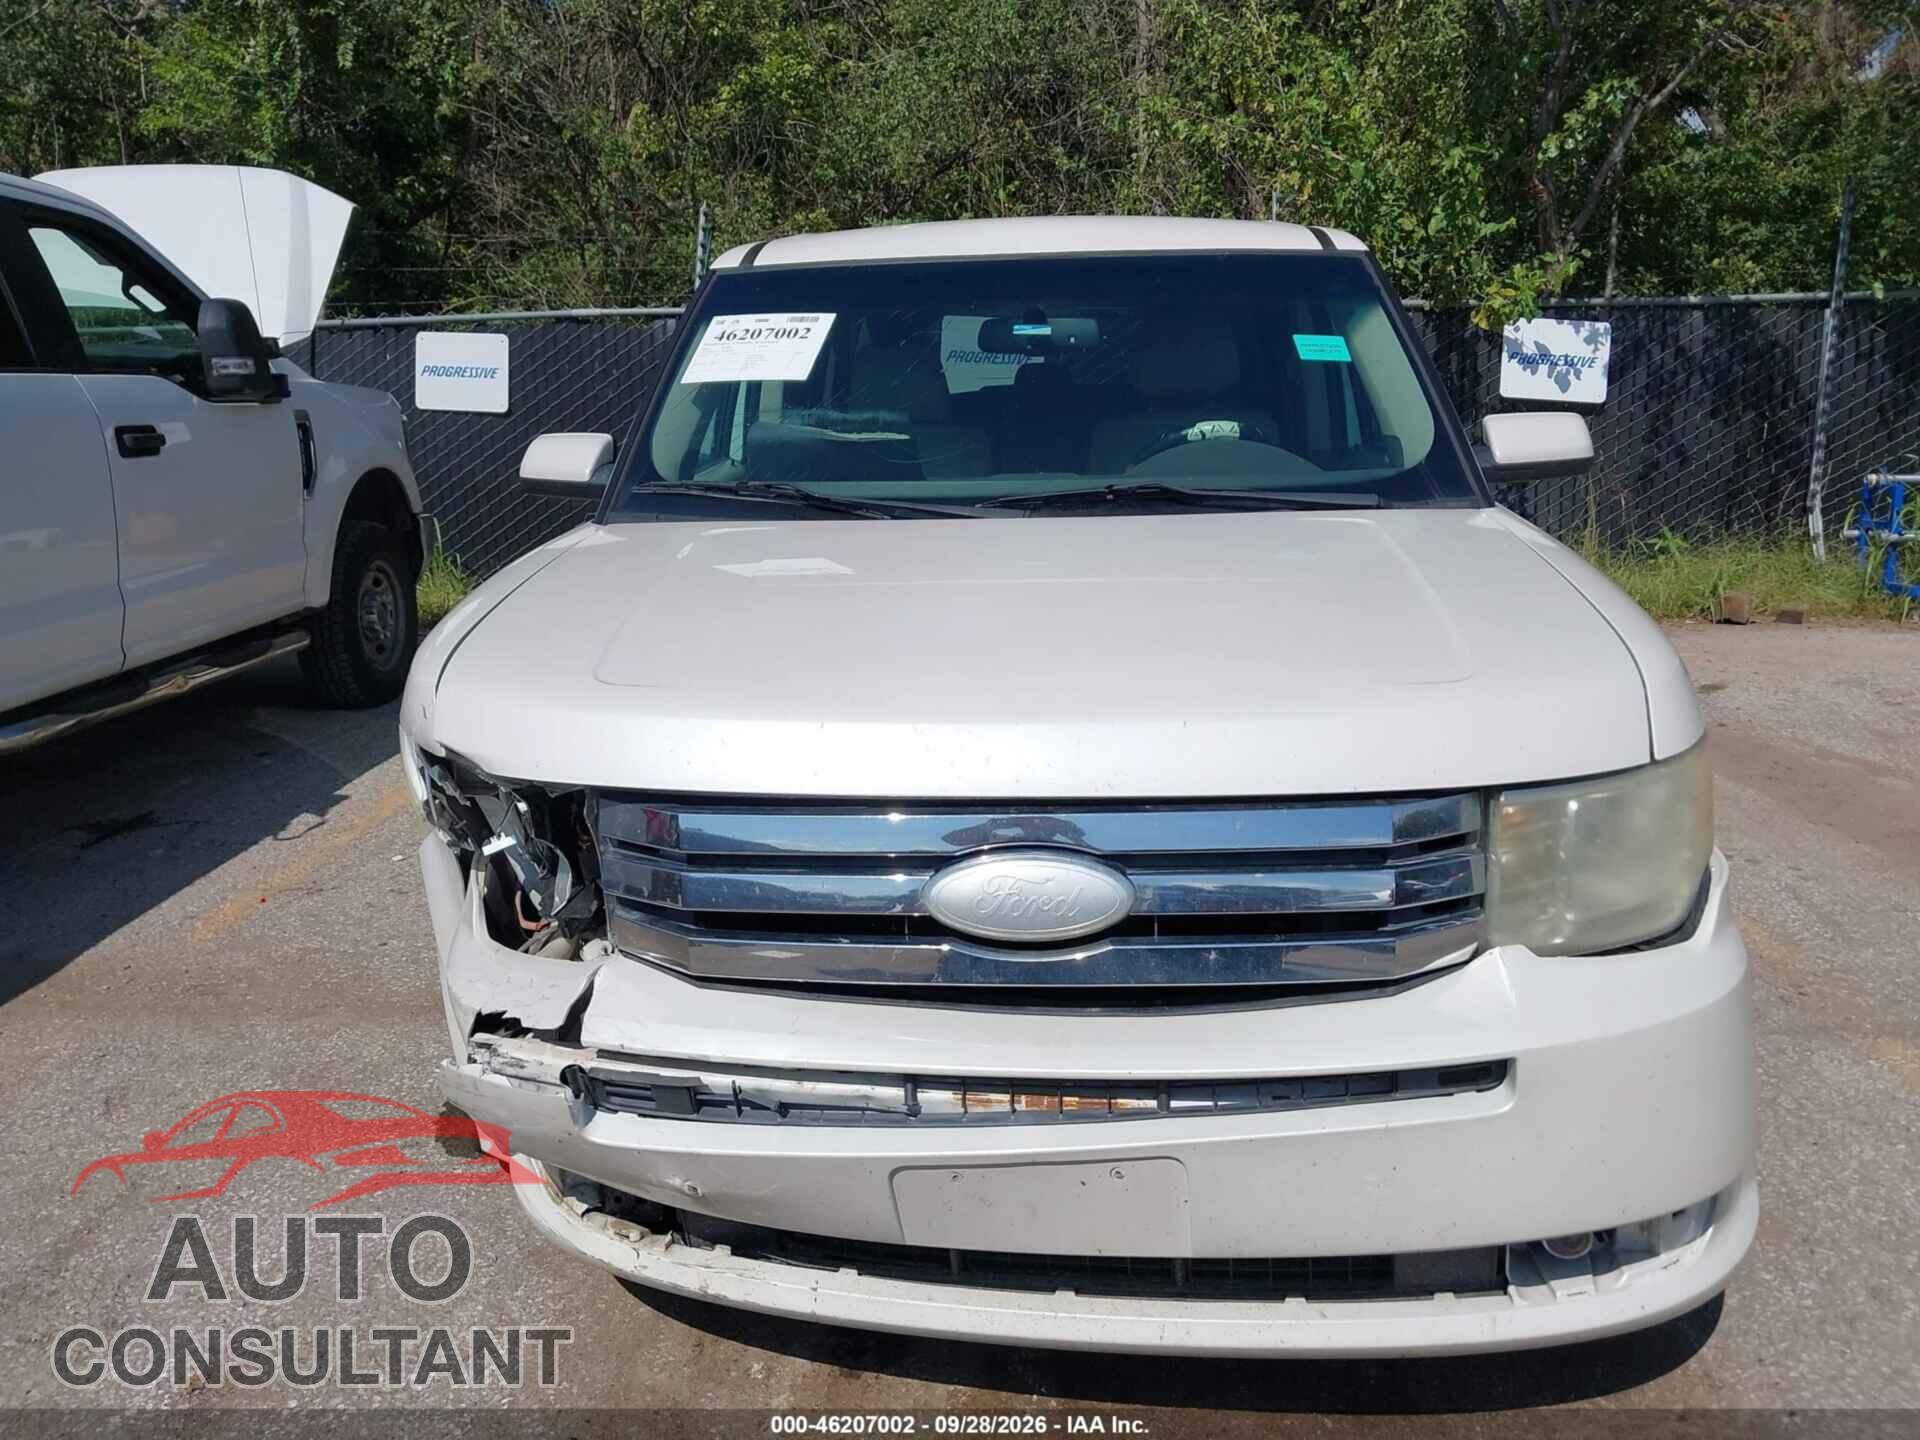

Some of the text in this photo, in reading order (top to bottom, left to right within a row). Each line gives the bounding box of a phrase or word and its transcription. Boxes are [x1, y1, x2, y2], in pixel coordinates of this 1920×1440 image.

[714, 327, 811, 342] 46207002
[946, 349, 1030, 366] PROGRESSIV
[1511, 351, 1600, 368] PROGRESSIVE
[421, 364, 499, 379] PROGRESSIVE
[975, 874, 1082, 918] Ford
